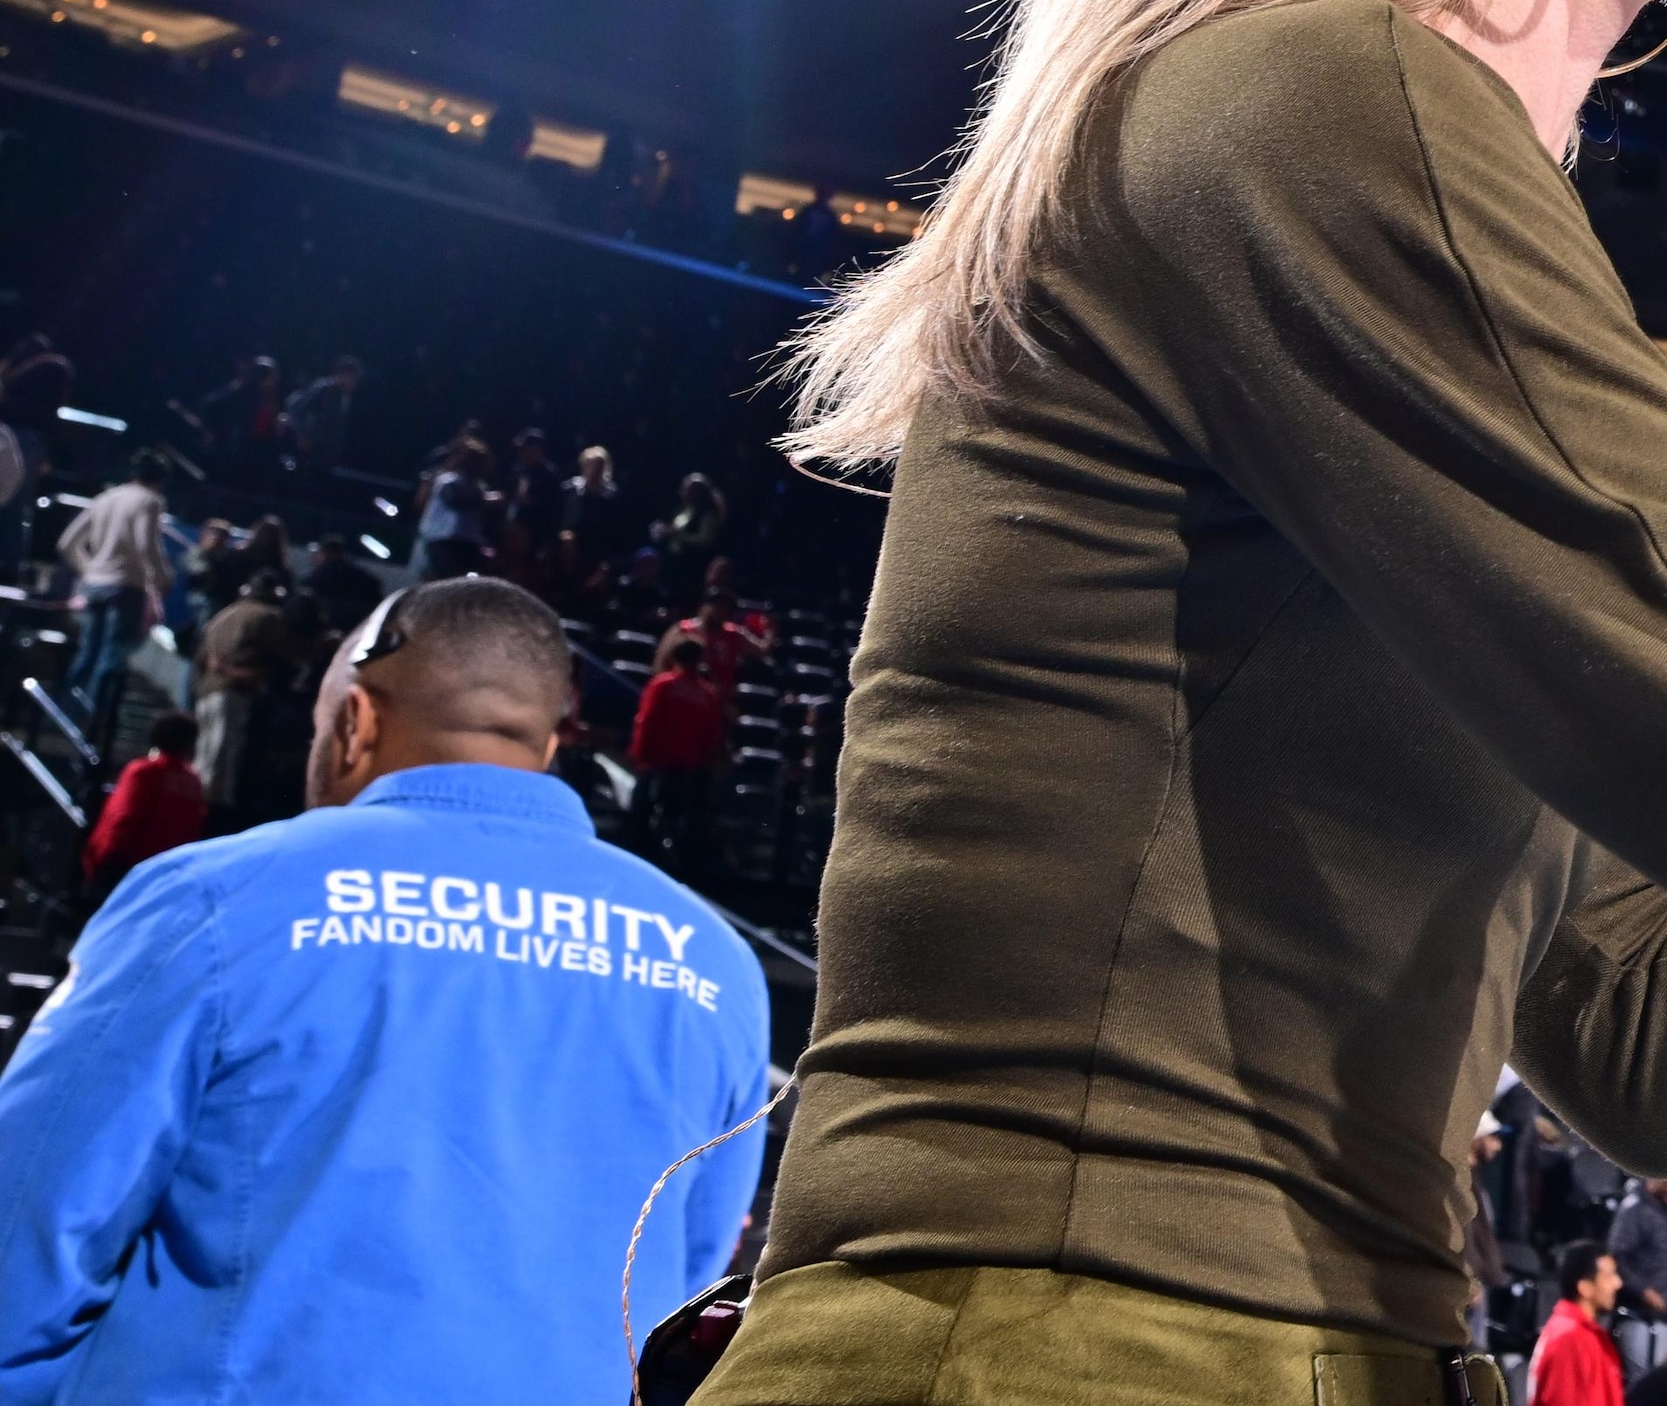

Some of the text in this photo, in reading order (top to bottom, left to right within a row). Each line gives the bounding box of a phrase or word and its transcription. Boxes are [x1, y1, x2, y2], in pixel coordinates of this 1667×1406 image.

[325, 868, 696, 962] SECURITY
[291, 915, 721, 1013] FANDOM LIVES HERE
